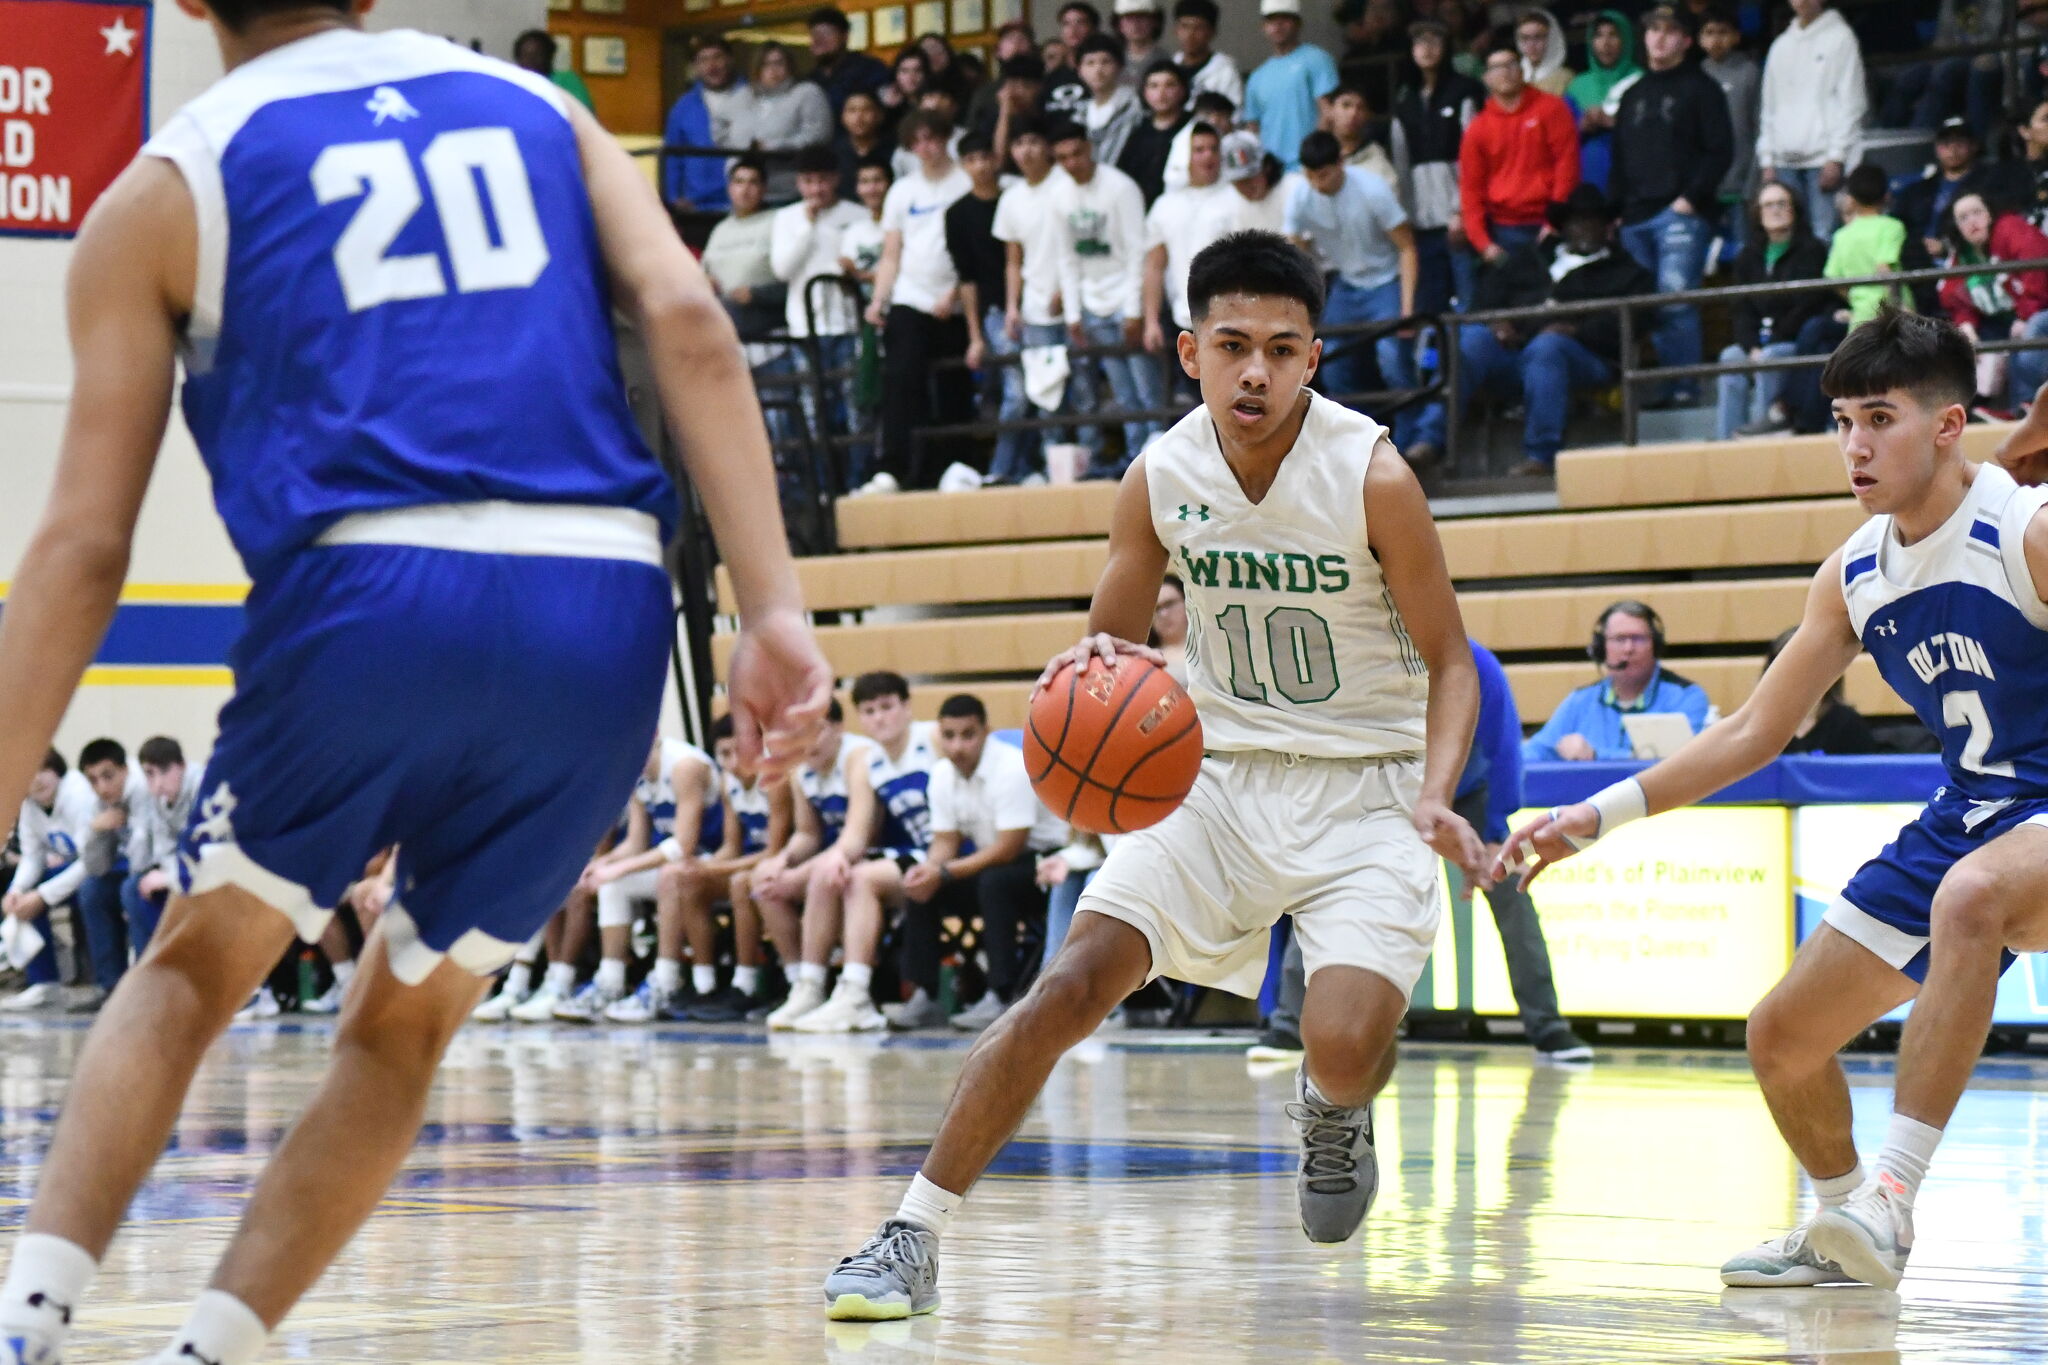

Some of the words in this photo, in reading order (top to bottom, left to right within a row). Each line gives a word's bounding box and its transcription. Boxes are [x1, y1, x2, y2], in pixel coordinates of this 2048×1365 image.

[0, 119, 35, 168] D
[308, 126, 552, 314] 20
[1180, 545, 1350, 594] WINDS
[1215, 604, 1341, 705] 10
[1906, 632, 1996, 686] OLTON
[1942, 690, 2017, 778] 2
[1535, 861, 1615, 884] onald's
[1624, 861, 1645, 883] of
[1654, 860, 1768, 884] Plainview
[1645, 898, 1729, 921] Pioneers
